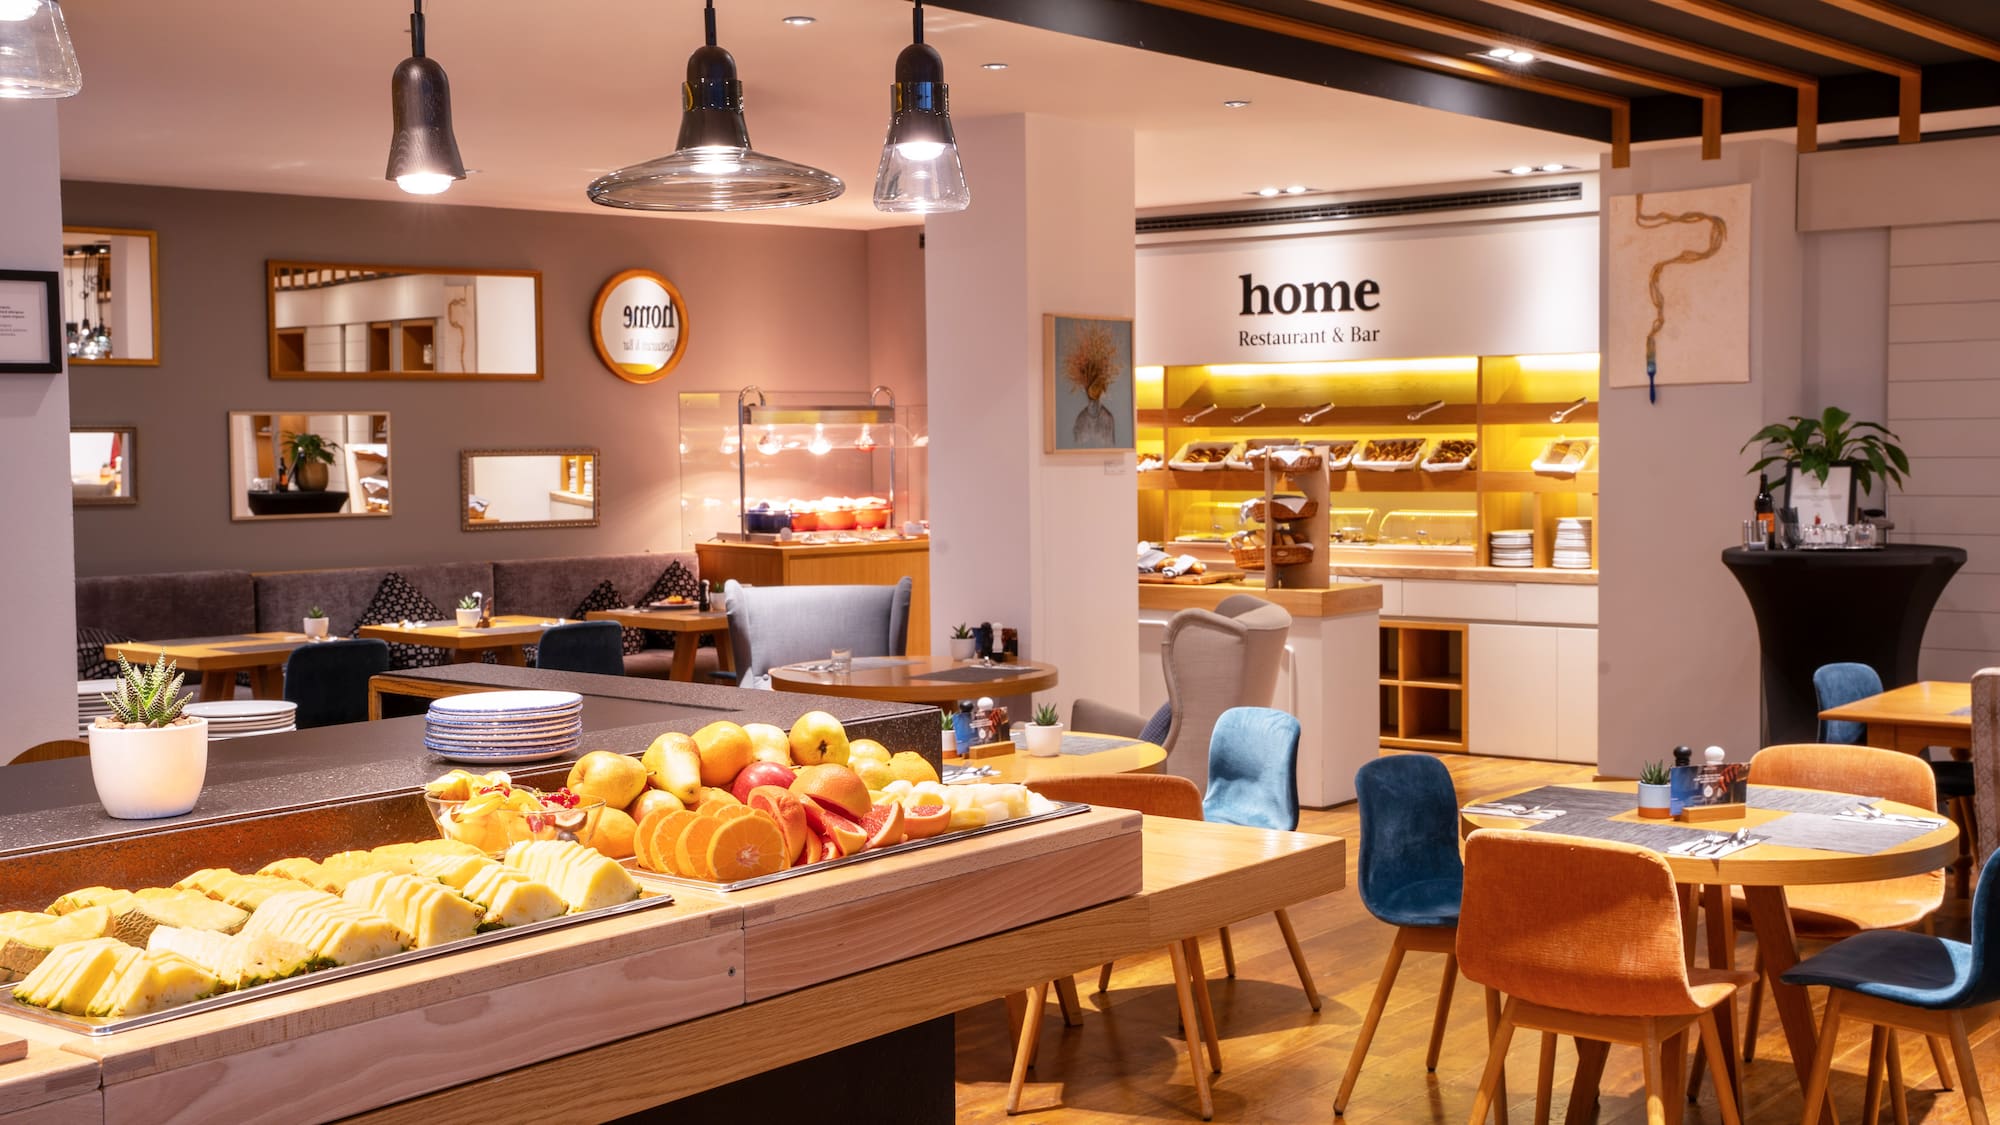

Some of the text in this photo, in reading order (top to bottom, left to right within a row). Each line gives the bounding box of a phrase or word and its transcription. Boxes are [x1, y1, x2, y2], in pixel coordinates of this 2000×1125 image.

[1238, 273, 1380, 315] home
[1239, 326, 1380, 347] Restaurant & Bar
